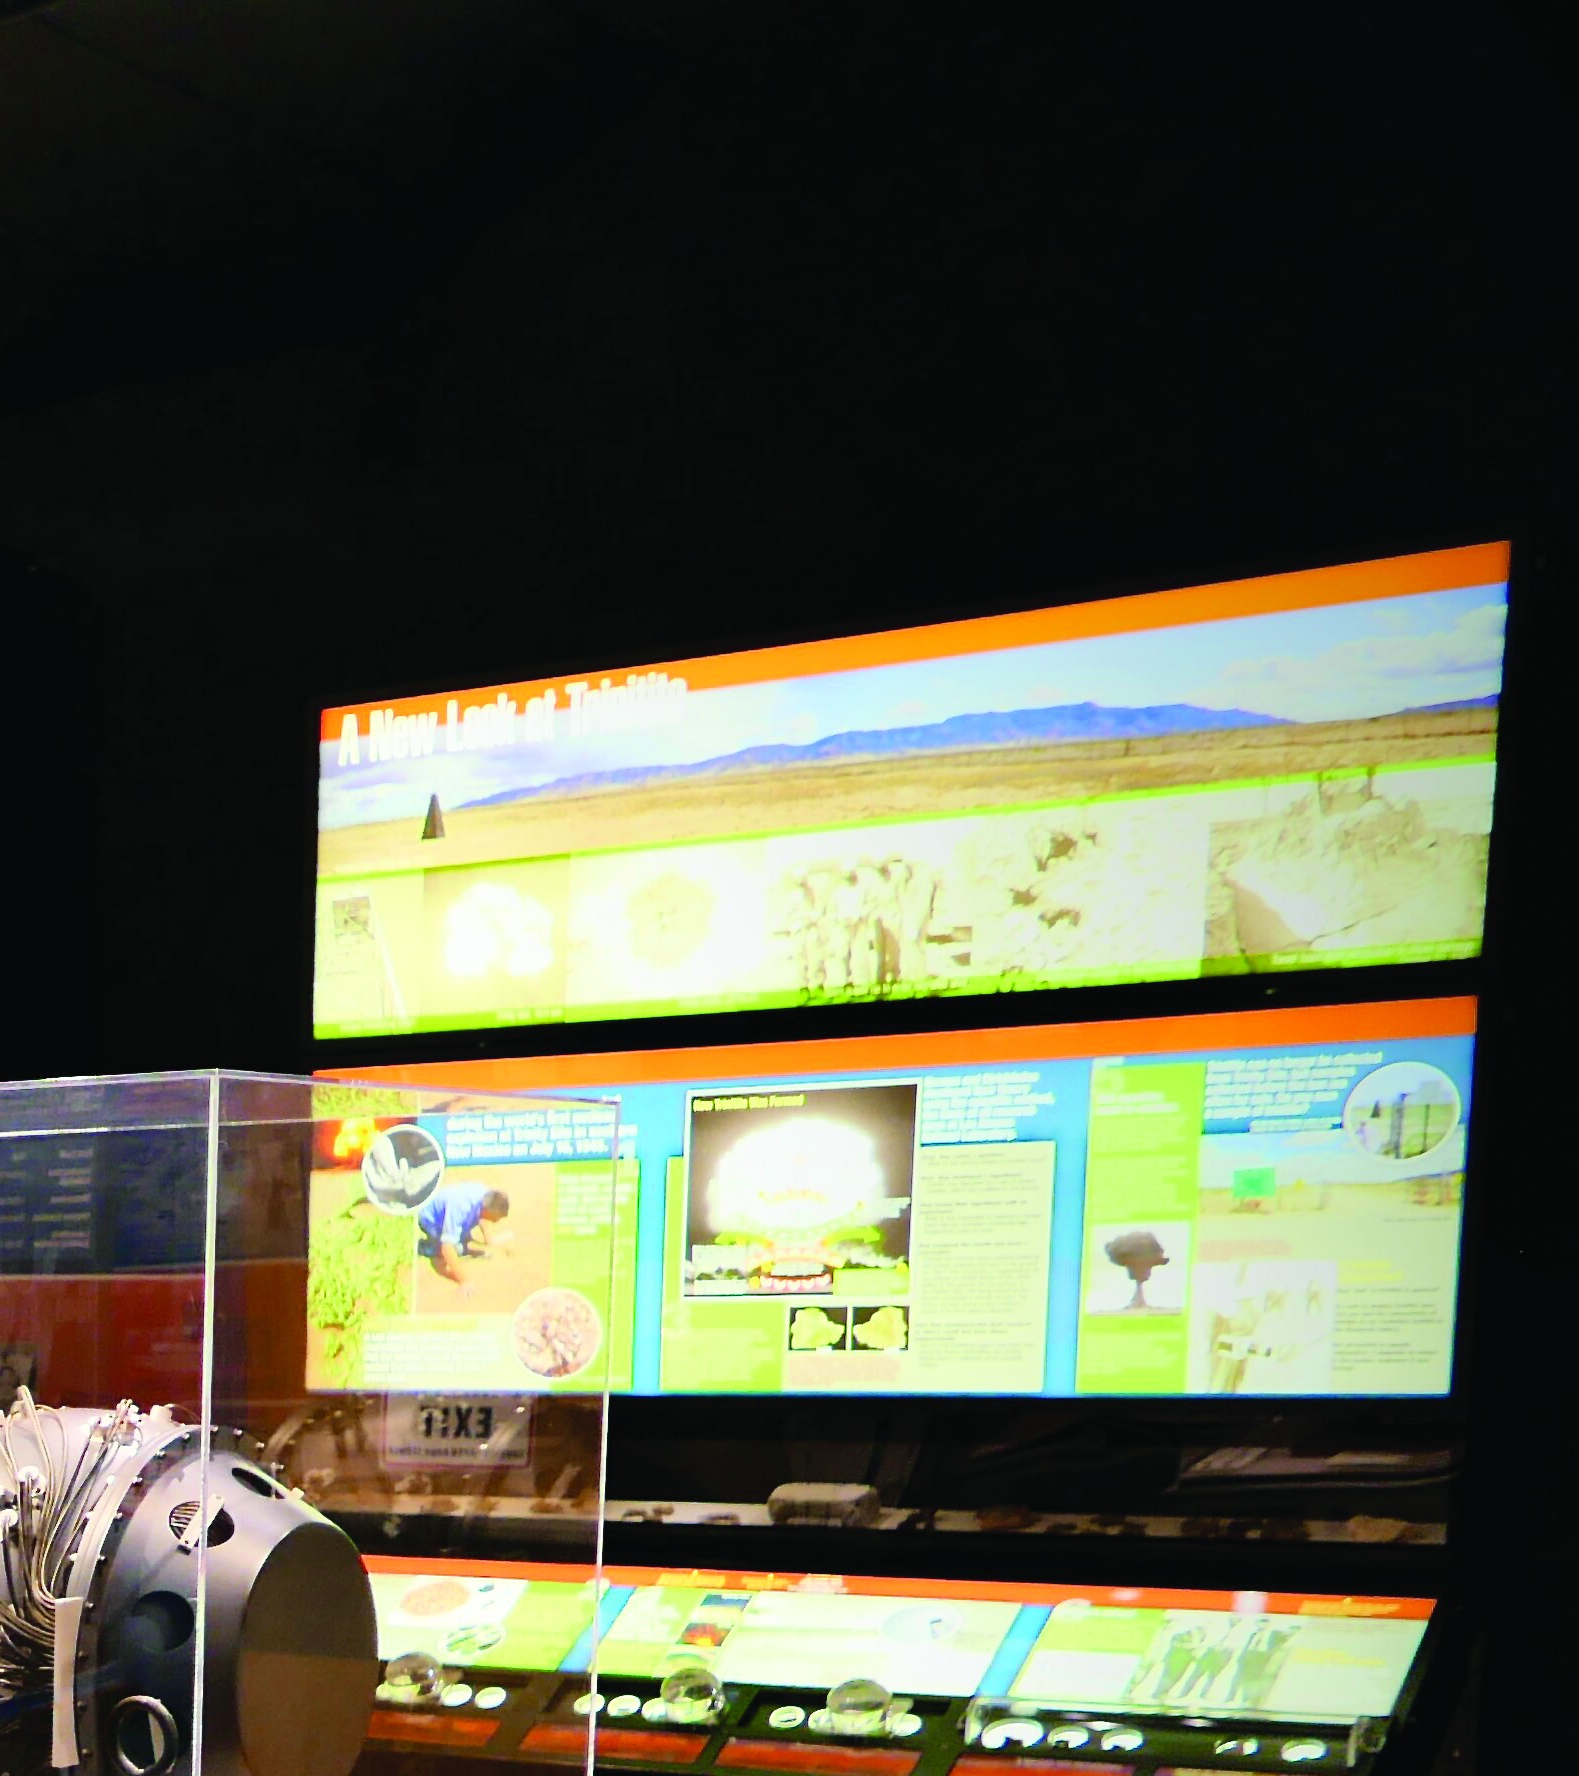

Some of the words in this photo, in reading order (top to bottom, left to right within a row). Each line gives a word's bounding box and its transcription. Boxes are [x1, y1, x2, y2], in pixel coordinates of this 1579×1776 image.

[338, 713, 360, 767] A
[369, 708, 438, 763] New
[446, 693, 517, 752] Look
[525, 688, 557, 741] at
[514, 1128, 549, 1143] Trinity
[446, 1145, 471, 1159] New
[471, 1144, 511, 1157] Mexico
[529, 1141, 554, 1157] July
